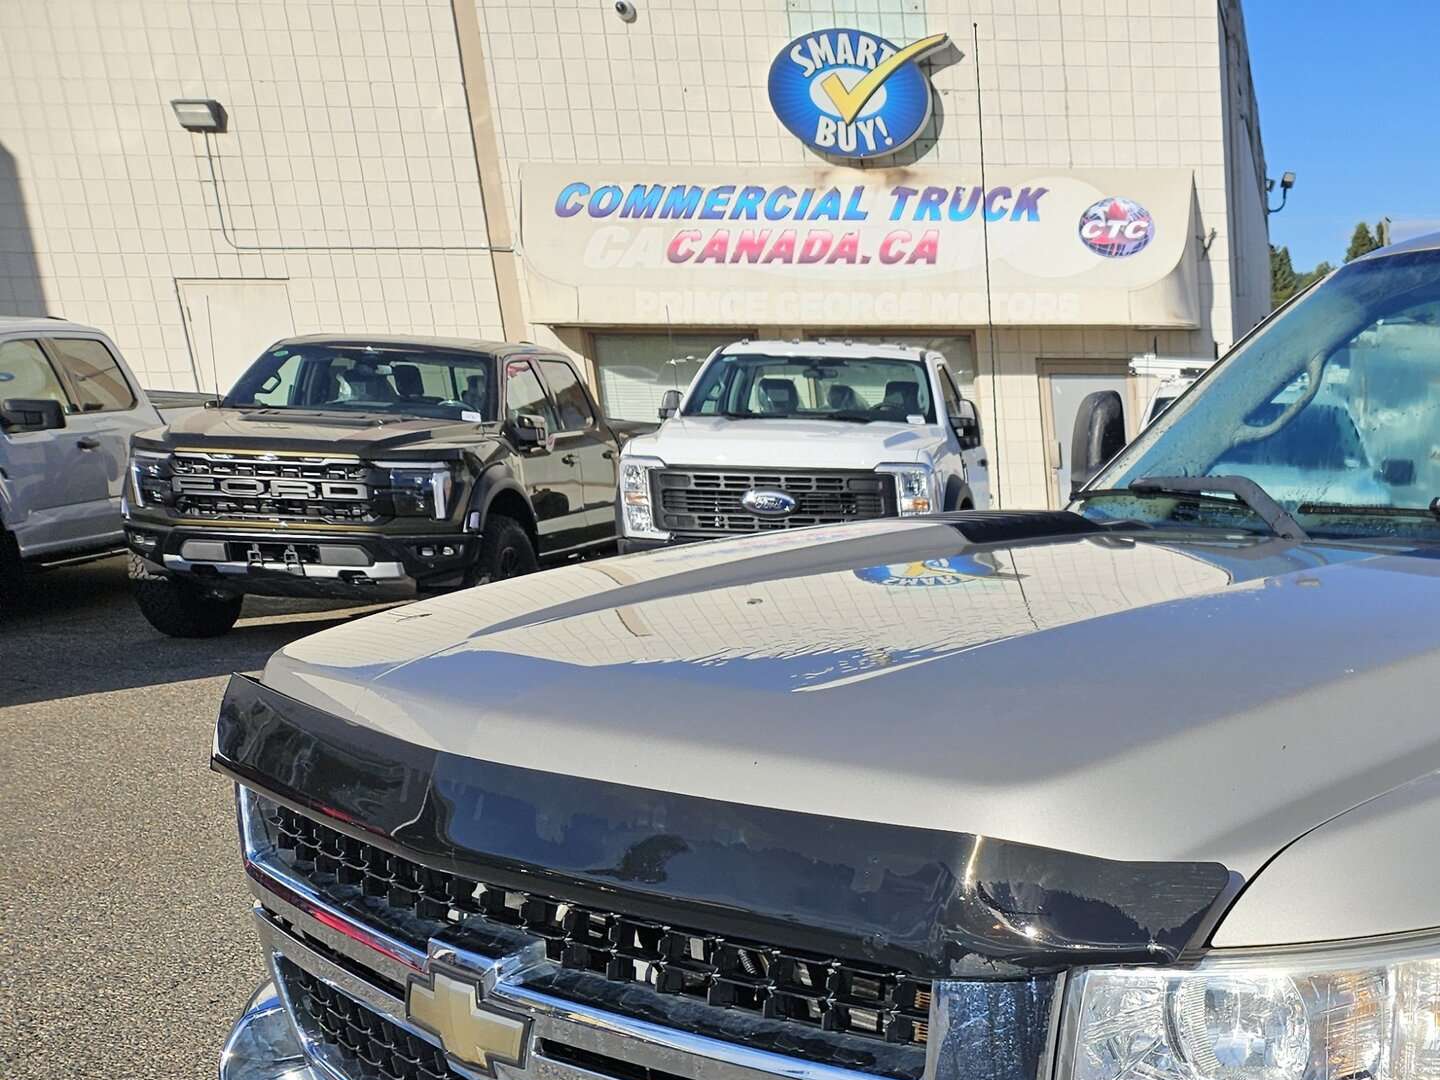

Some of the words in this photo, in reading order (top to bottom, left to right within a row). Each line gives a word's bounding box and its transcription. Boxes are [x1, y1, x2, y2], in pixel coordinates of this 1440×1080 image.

[790, 33, 899, 78] SMART
[814, 115, 893, 153] BUY!
[554, 181, 869, 221] COMMERCIAL
[889, 185, 1050, 223] TRUCK
[666, 228, 941, 265] CANADA.CA
[1081, 220, 1149, 239] CTC
[171, 474, 370, 500] FORD
